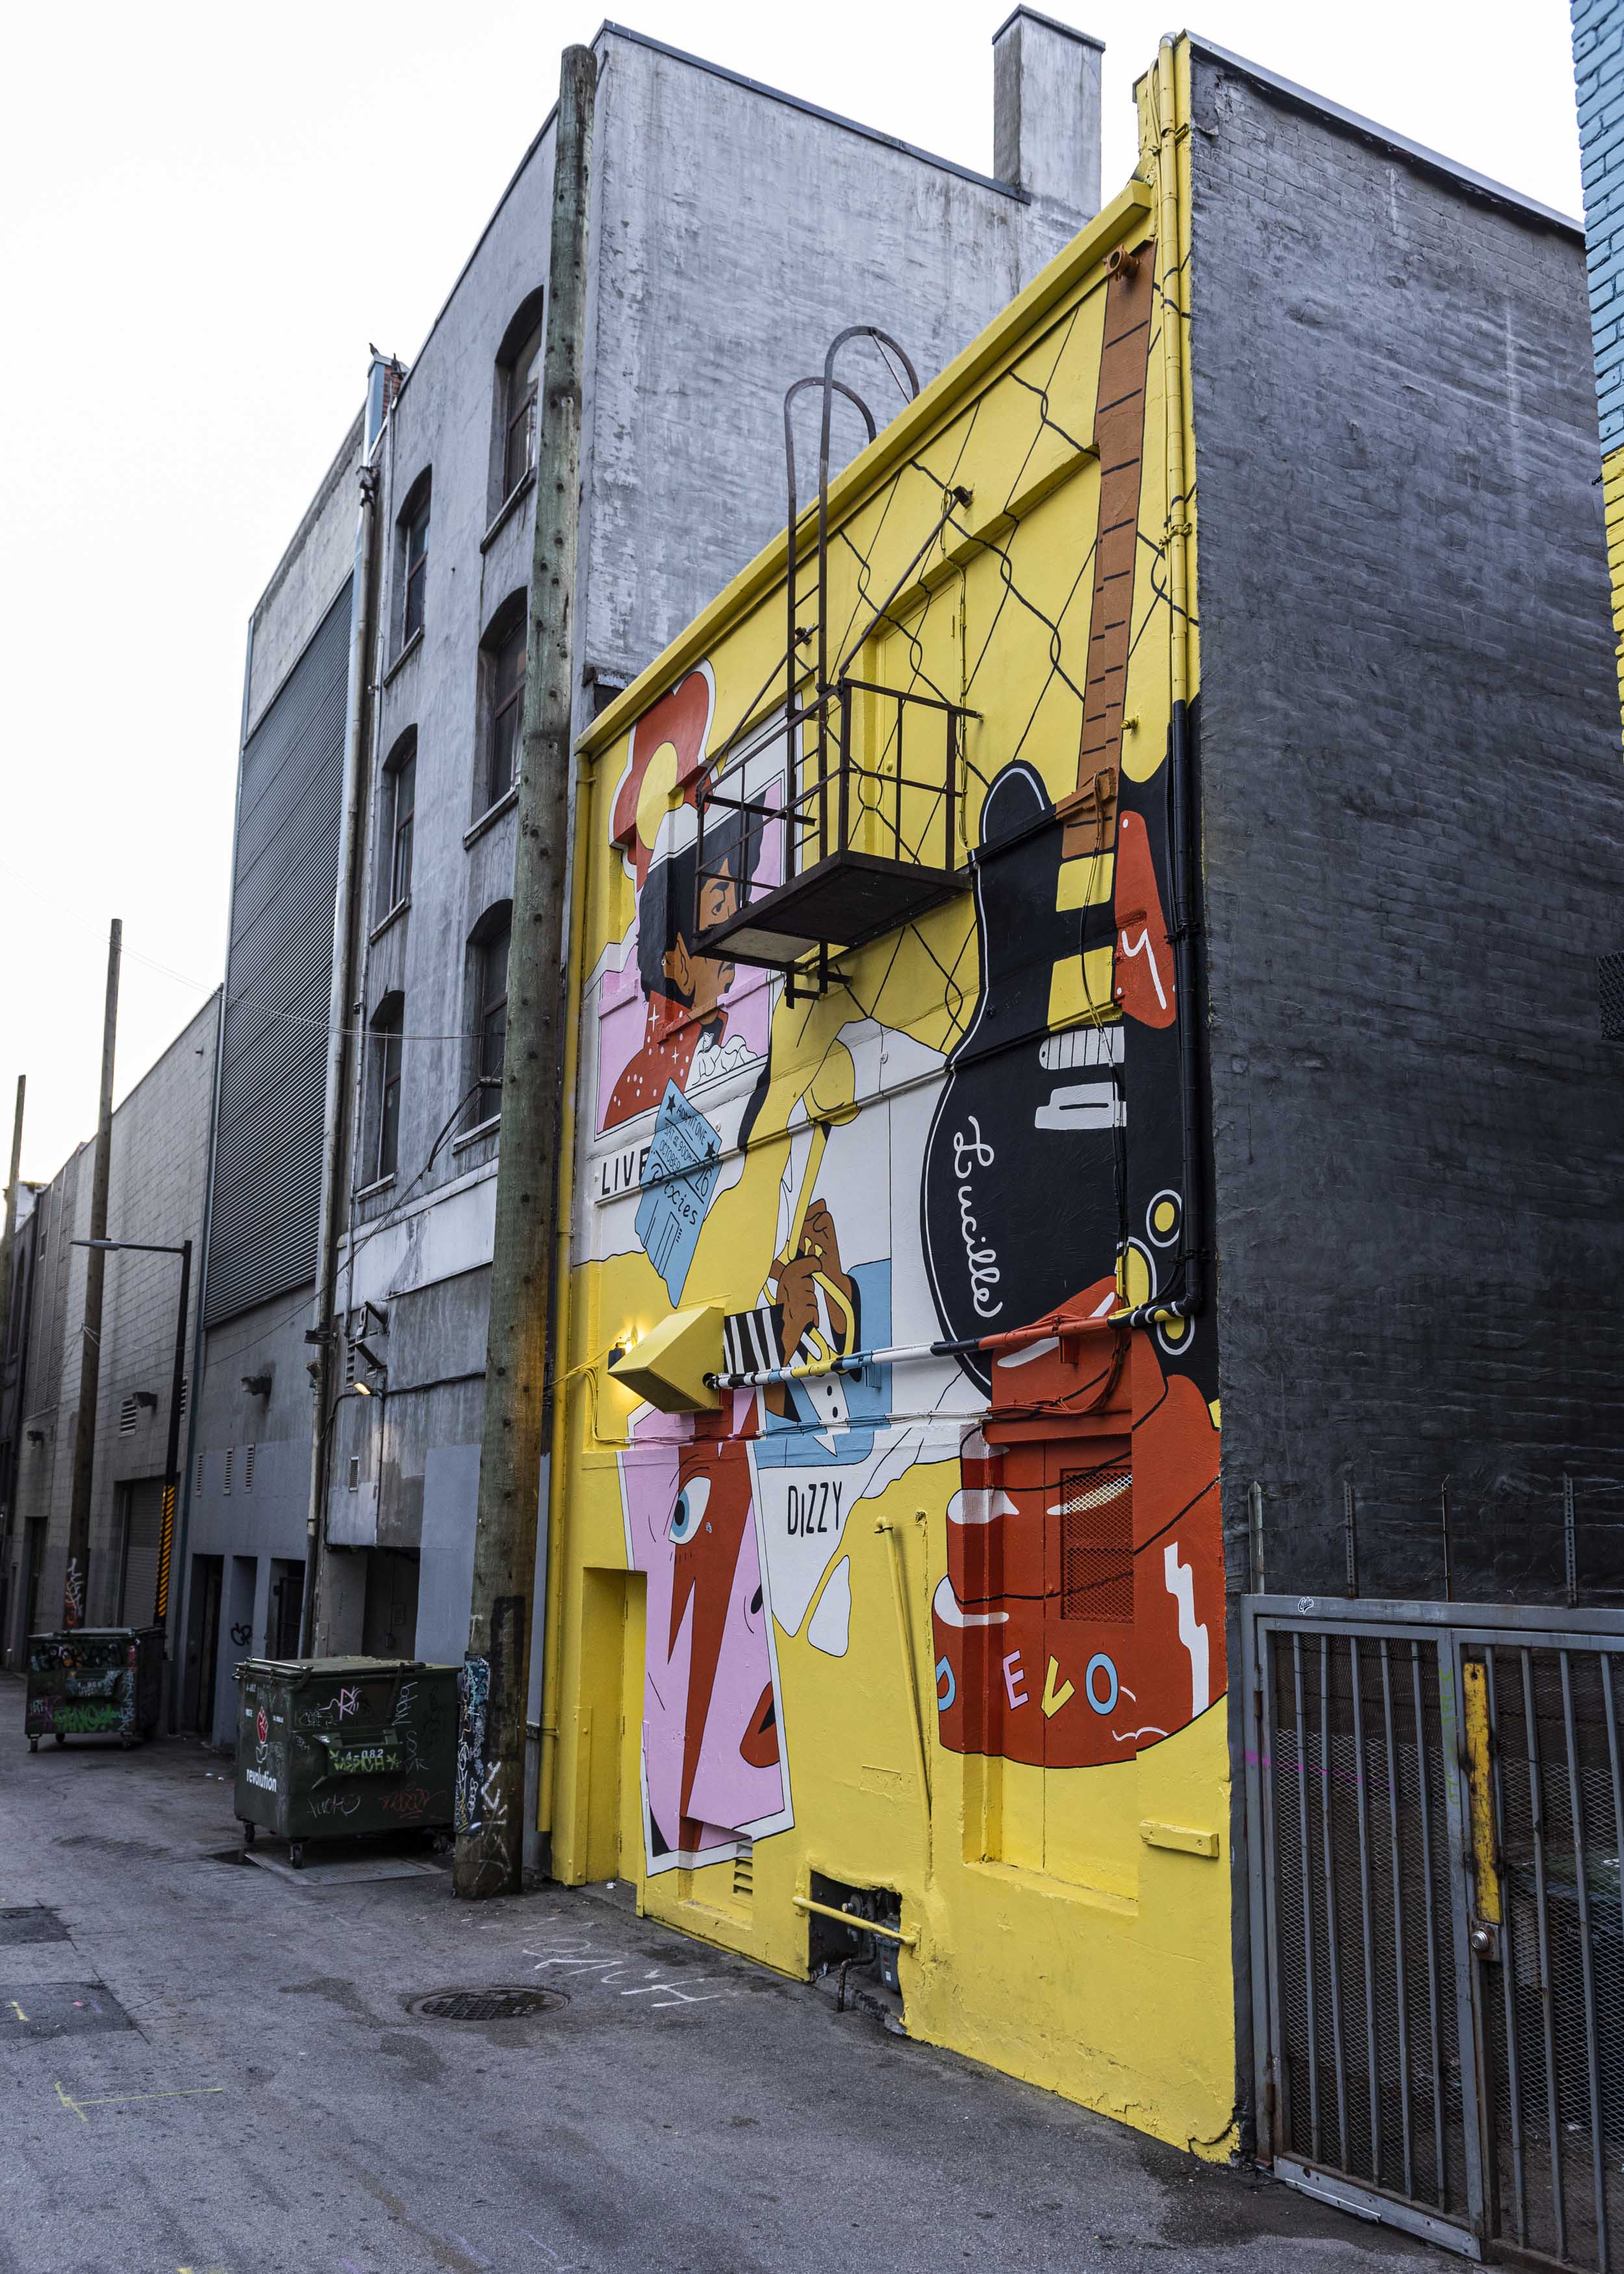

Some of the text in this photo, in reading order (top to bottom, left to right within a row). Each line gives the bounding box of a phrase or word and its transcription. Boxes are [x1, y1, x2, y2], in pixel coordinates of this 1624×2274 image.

[676, 1104, 707, 1145] ADMIT ONE
[602, 1146, 652, 1195] LIVE
[953, 1115, 1003, 1318] Lucille
[787, 1481, 843, 1537] DIZZY
[935, 1649, 1119, 1720] DEVO
[246, 1767, 277, 1793] revolution
